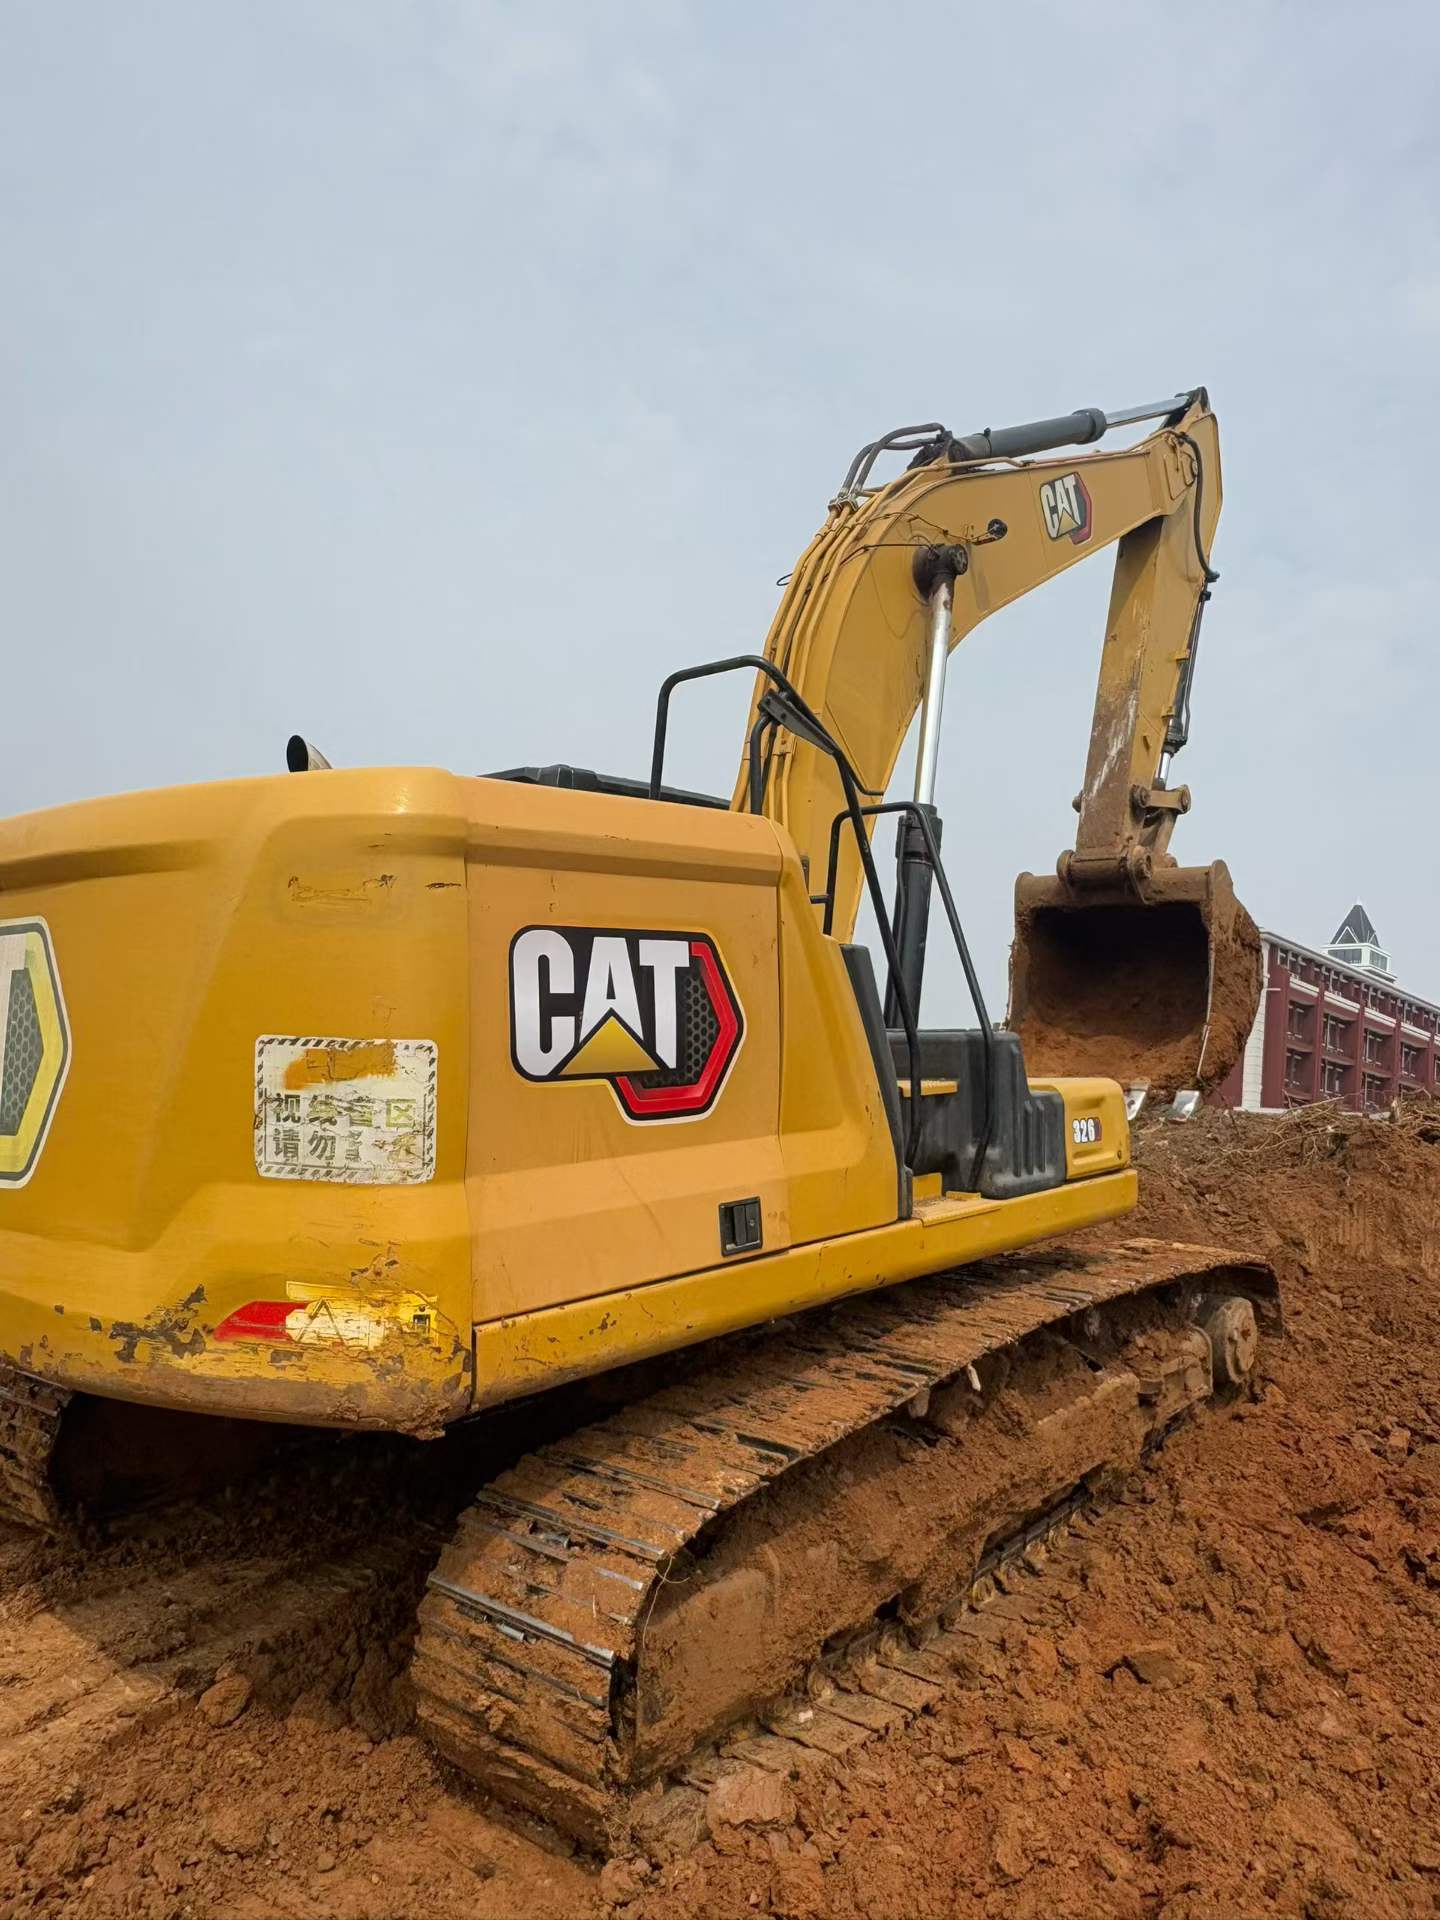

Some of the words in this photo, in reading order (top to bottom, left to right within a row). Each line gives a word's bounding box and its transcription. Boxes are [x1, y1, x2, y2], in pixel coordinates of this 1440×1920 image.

[1040, 474, 1081, 539] CAT
[512, 929, 690, 1077] CAT
[1072, 1118, 1096, 1144] 326
